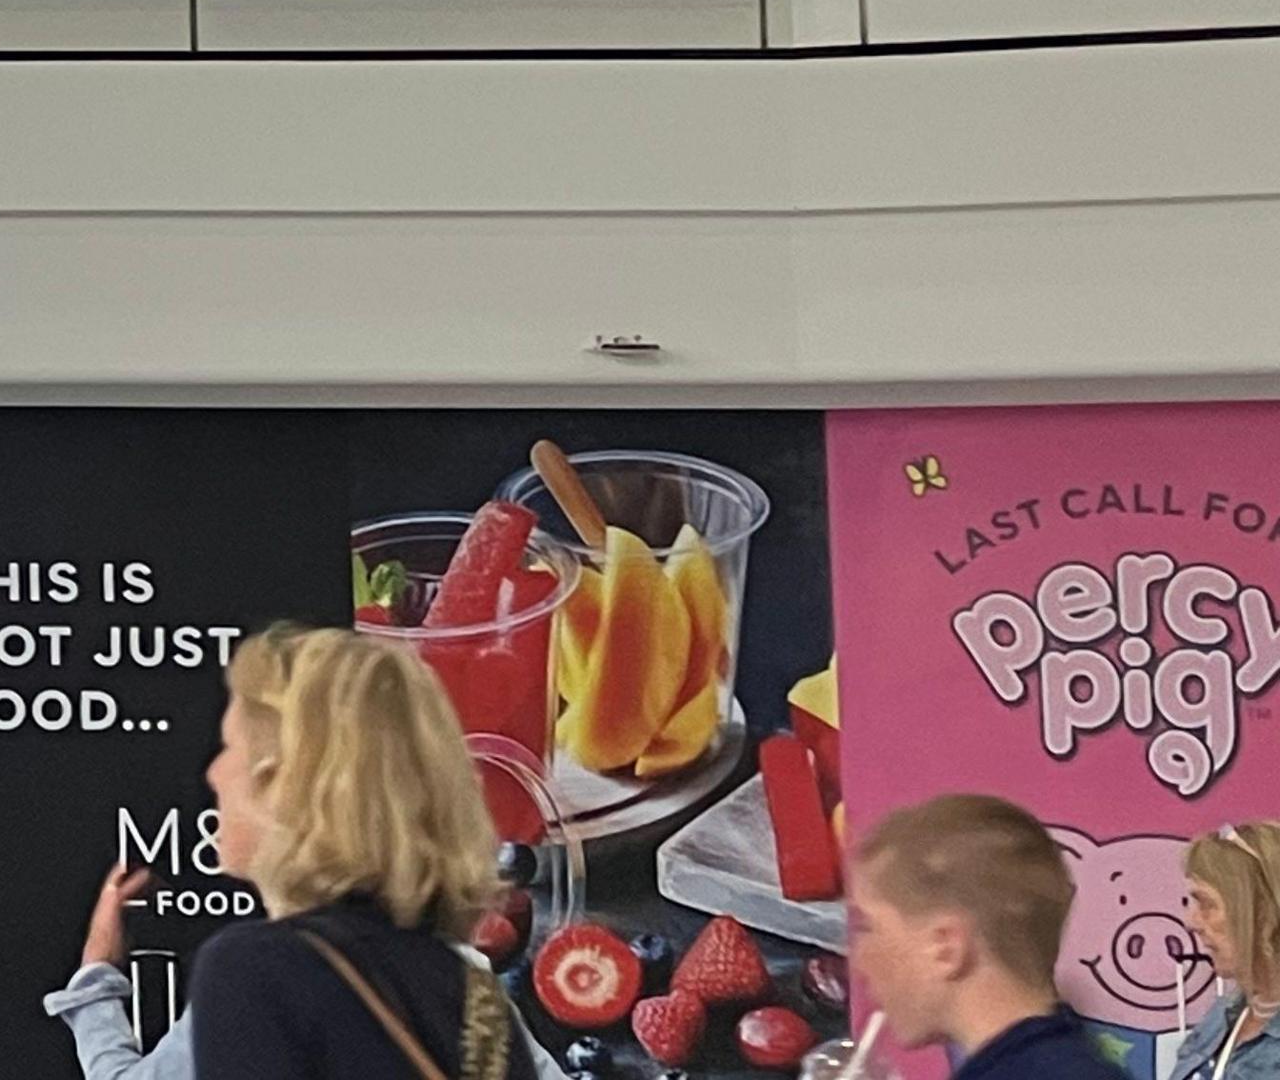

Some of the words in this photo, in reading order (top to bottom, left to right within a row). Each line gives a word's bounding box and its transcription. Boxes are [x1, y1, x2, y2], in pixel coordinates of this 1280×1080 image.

[934, 498, 1040, 575] LAST
[1060, 484, 1186, 519] CALL
[102, 561, 154, 603] IS
[93, 625, 241, 667] JUST
[951, 551, 1280, 703] percy
[1040, 635, 1236, 797] pig
[118, 807, 224, 876] M&
[156, 890, 255, 916] FOOD
